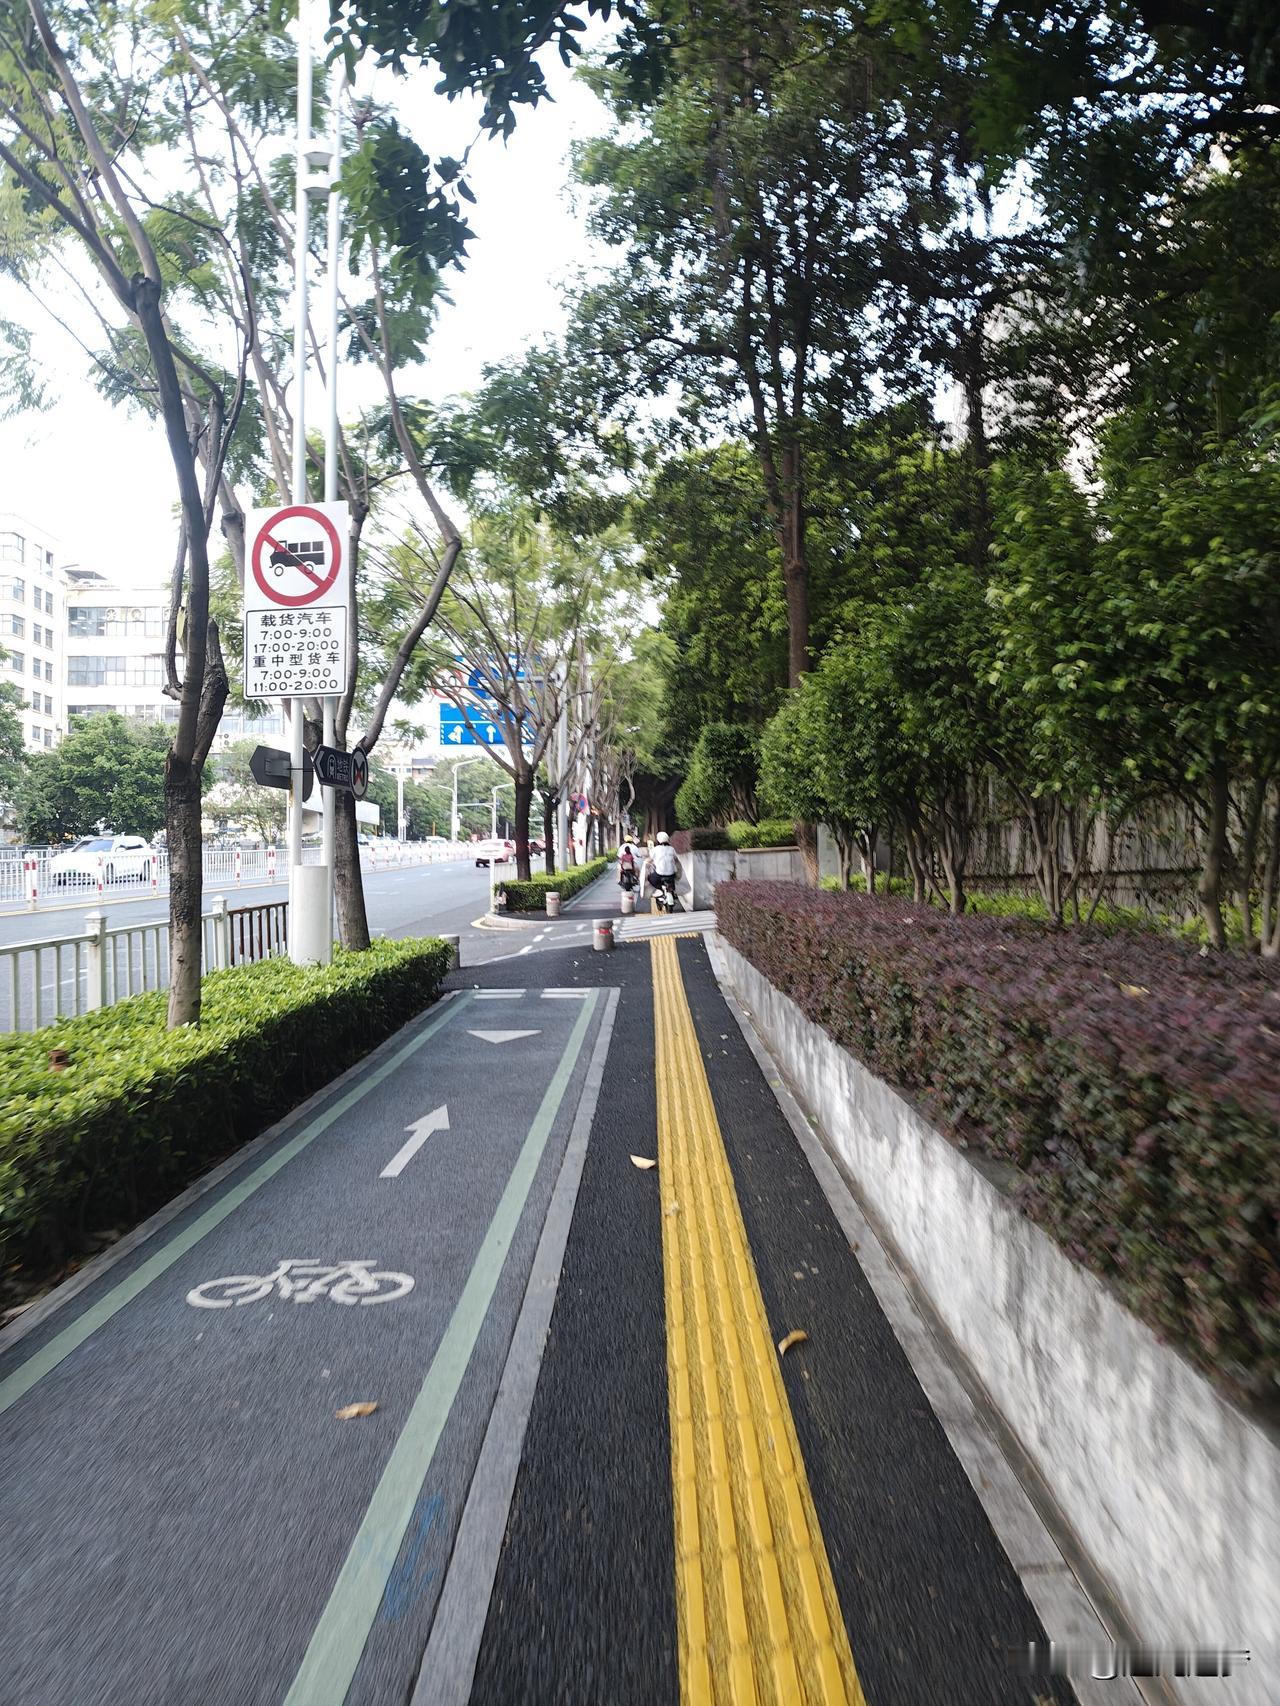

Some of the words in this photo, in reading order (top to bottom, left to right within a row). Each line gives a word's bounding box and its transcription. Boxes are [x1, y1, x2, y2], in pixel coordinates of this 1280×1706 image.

[260, 612, 332, 627] 载货汽车
[260, 628, 332, 640] 7:00-9:00
[254, 640, 339, 653] 17:00-20:00
[253, 652, 340, 668] 重中型货车
[260, 668, 331, 680] 7:00-9:00
[254, 680, 338, 692] 11:00-20:00
